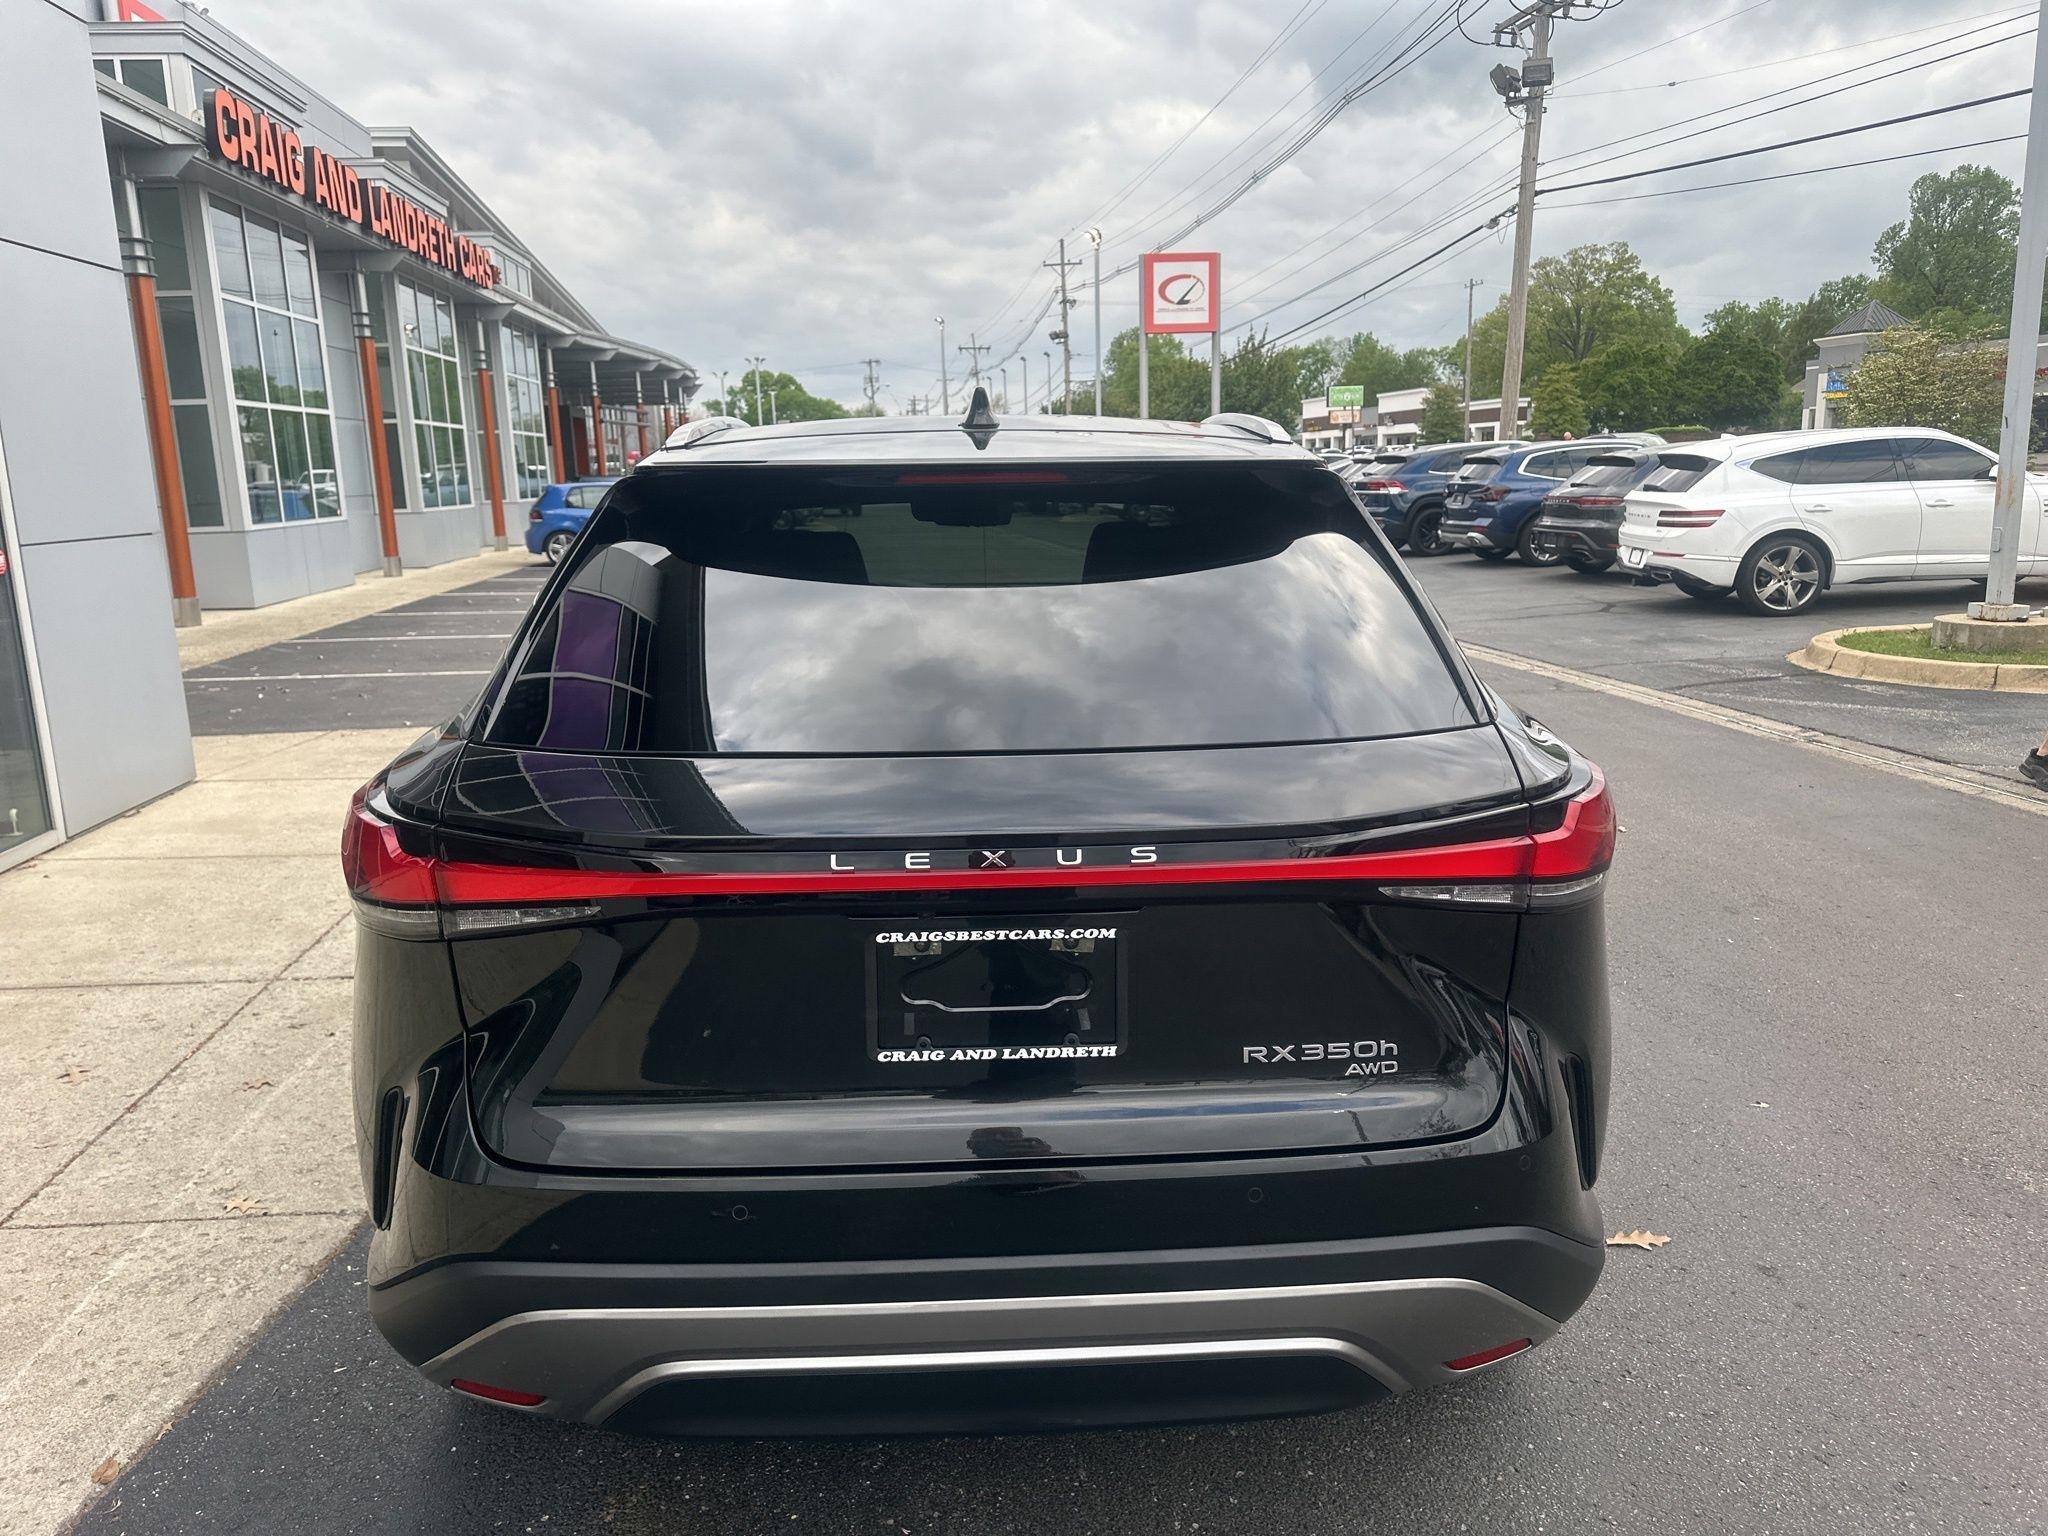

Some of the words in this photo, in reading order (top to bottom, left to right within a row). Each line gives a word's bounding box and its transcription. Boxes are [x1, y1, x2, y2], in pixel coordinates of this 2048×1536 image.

[214, 88, 305, 196] CRAIG
[313, 145, 363, 224] AND
[366, 178, 458, 272] LANDRETH
[458, 234, 493, 290] CARS
[830, 846, 1158, 871] LEXUS
[875, 927, 1117, 944] CRAIGSBESTCARS.COM
[877, 1049, 946, 1063] CRAIG
[949, 1047, 998, 1061] AND
[1001, 1045, 1118, 1060] LANDRETH
[1344, 1060, 1399, 1077] AWD
